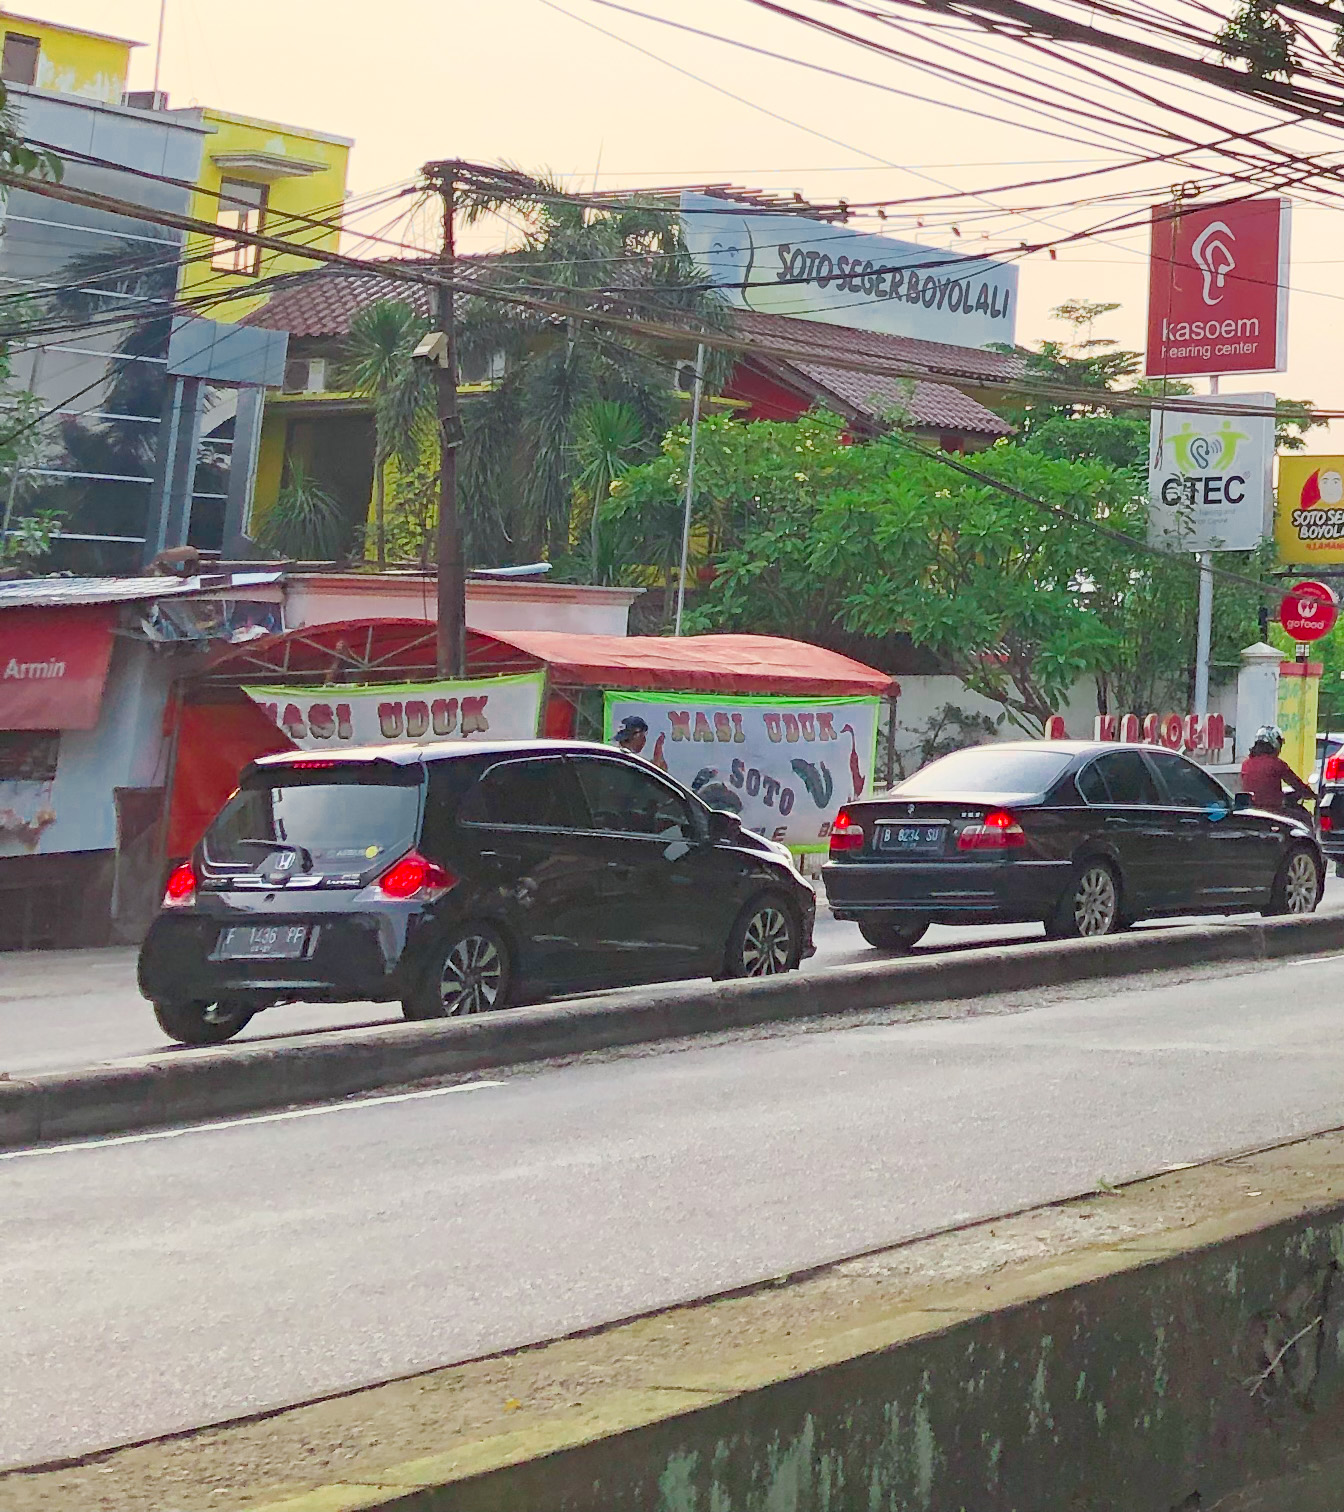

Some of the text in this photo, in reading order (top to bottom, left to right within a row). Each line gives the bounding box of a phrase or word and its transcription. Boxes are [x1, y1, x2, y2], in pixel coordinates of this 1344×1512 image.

[777, 244, 833, 289] SOTO
[907, 270, 1010, 319] BOYOLALI
[1162, 318, 1259, 341] kasoem
[1161, 342, 1258, 359] hearing center
[1162, 476, 1246, 506] CTEC
[1293, 510, 1326, 526] SOTO
[1287, 619, 1325, 630] gofood
[3, 657, 66, 679] Armin
[378, 695, 489, 739] UDUK
[667, 711, 837, 743] NASI UDUK
[729, 758, 795, 816] SOTO
